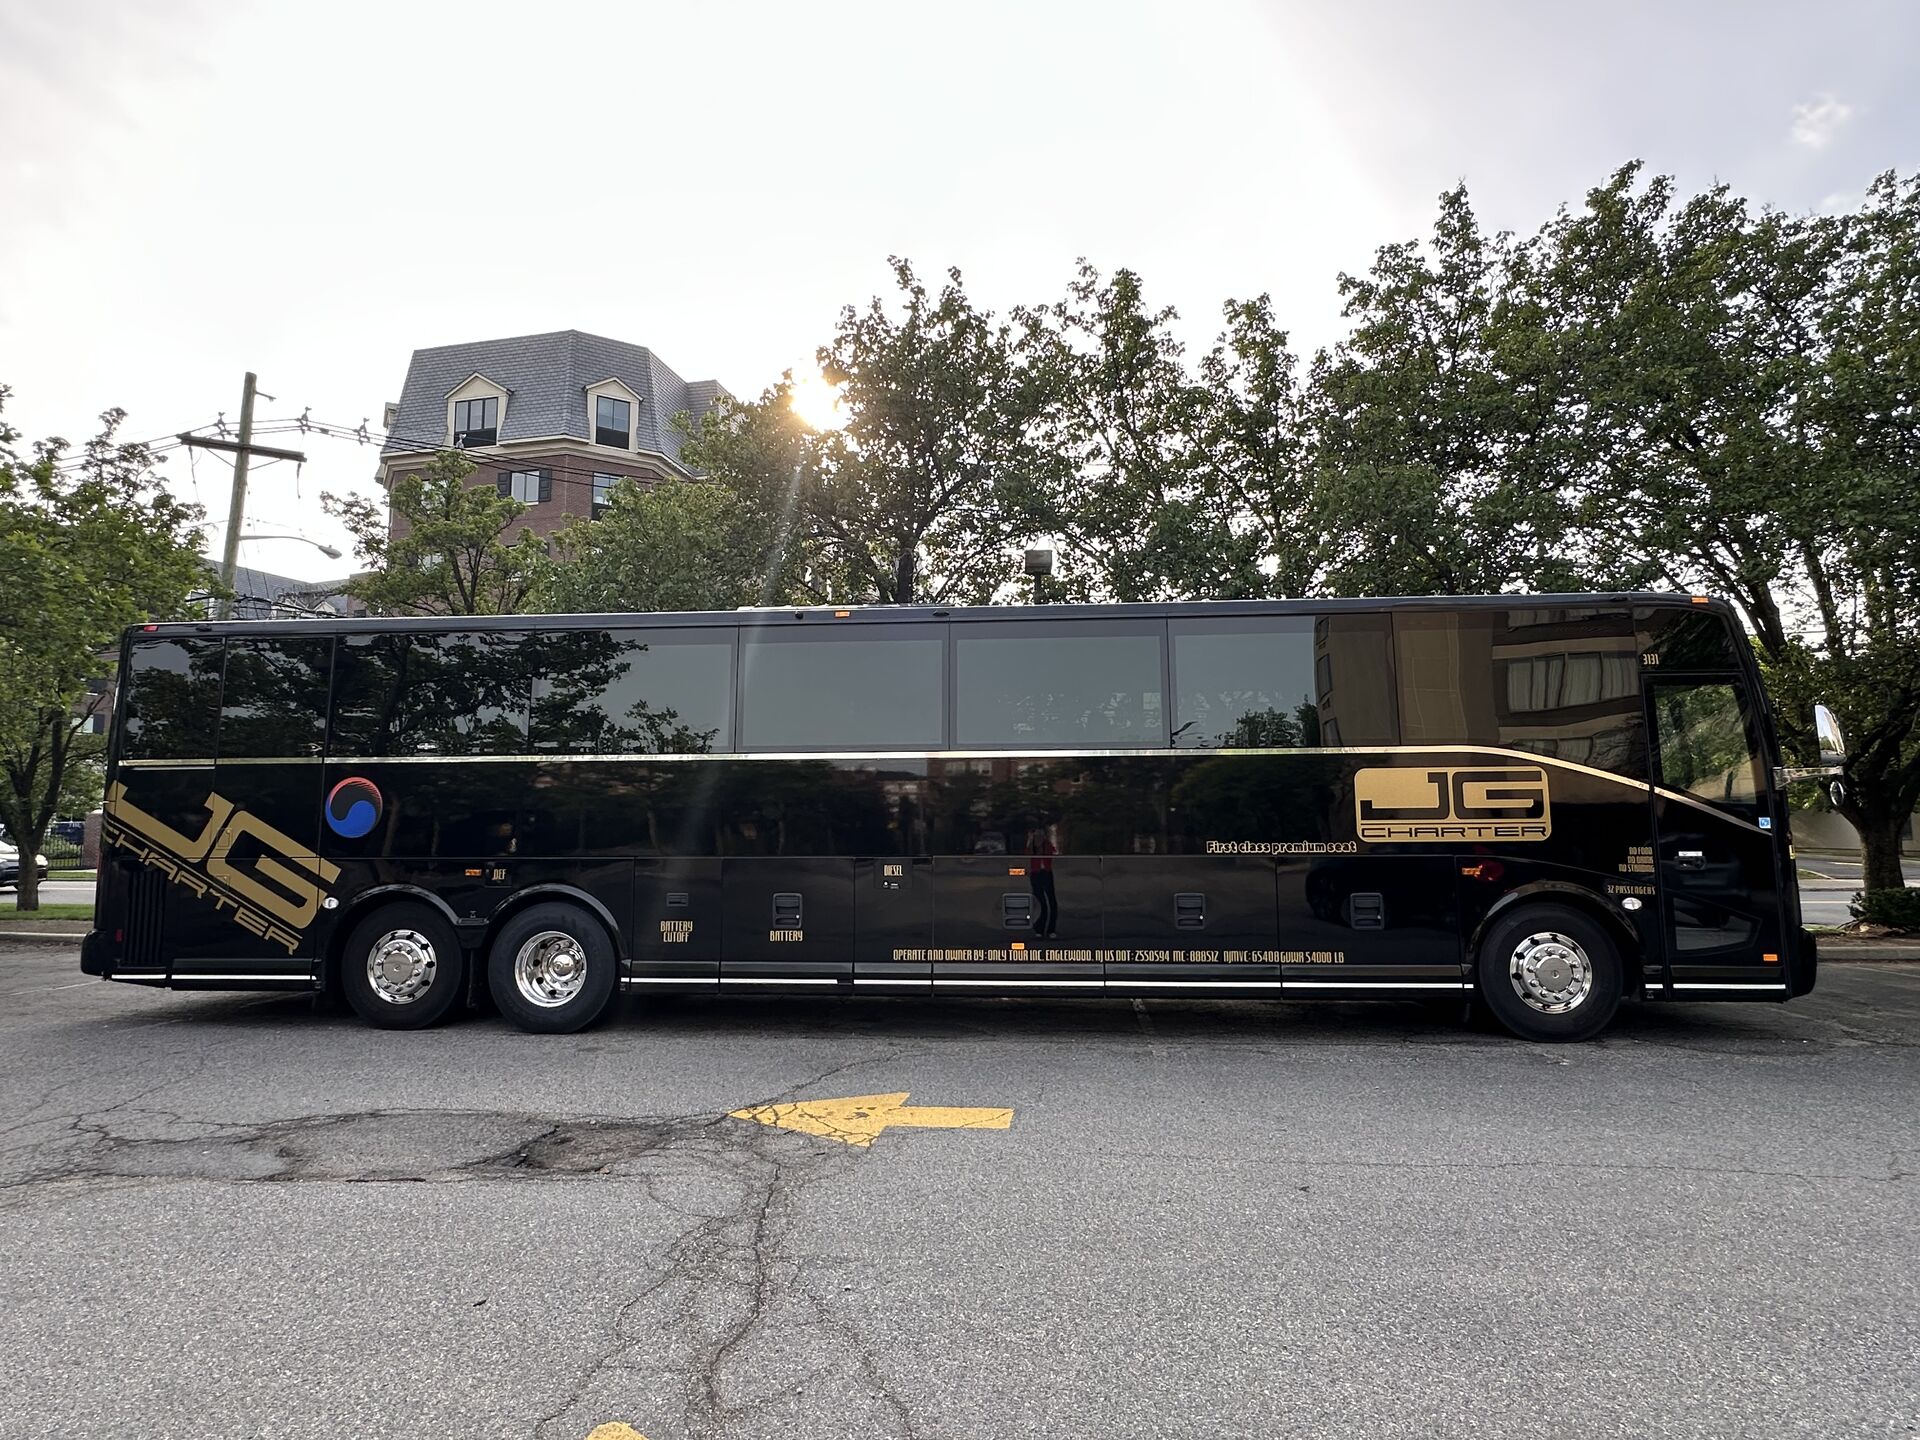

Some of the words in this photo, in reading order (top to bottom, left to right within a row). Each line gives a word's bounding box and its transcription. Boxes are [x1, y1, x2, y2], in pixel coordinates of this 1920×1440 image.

[1642, 653, 1659, 665] 3131
[1360, 771, 1545, 820] JG
[1361, 826, 1547, 837] CHARTER
[1206, 841, 1237, 853] First
[1238, 841, 1270, 853] class
[1271, 840, 1327, 855] premium
[1327, 841, 1357, 853] seat
[105, 779, 342, 929] JG
[492, 868, 507, 880] DEF
[883, 865, 903, 877] DIESEL
[101, 818, 300, 955] CHARTER
[660, 920, 693, 932] BATTERY
[663, 931, 689, 943] CUTOFF
[769, 930, 803, 942] BATTERY
[893, 949, 926, 961] OPERATE
[927, 949, 944, 961] AND
[945, 949, 972, 961] OWNER
[1008, 949, 1029, 961] TOUR
[1305, 951, 1332, 964] 54000
[1334, 951, 1345, 964] LB
